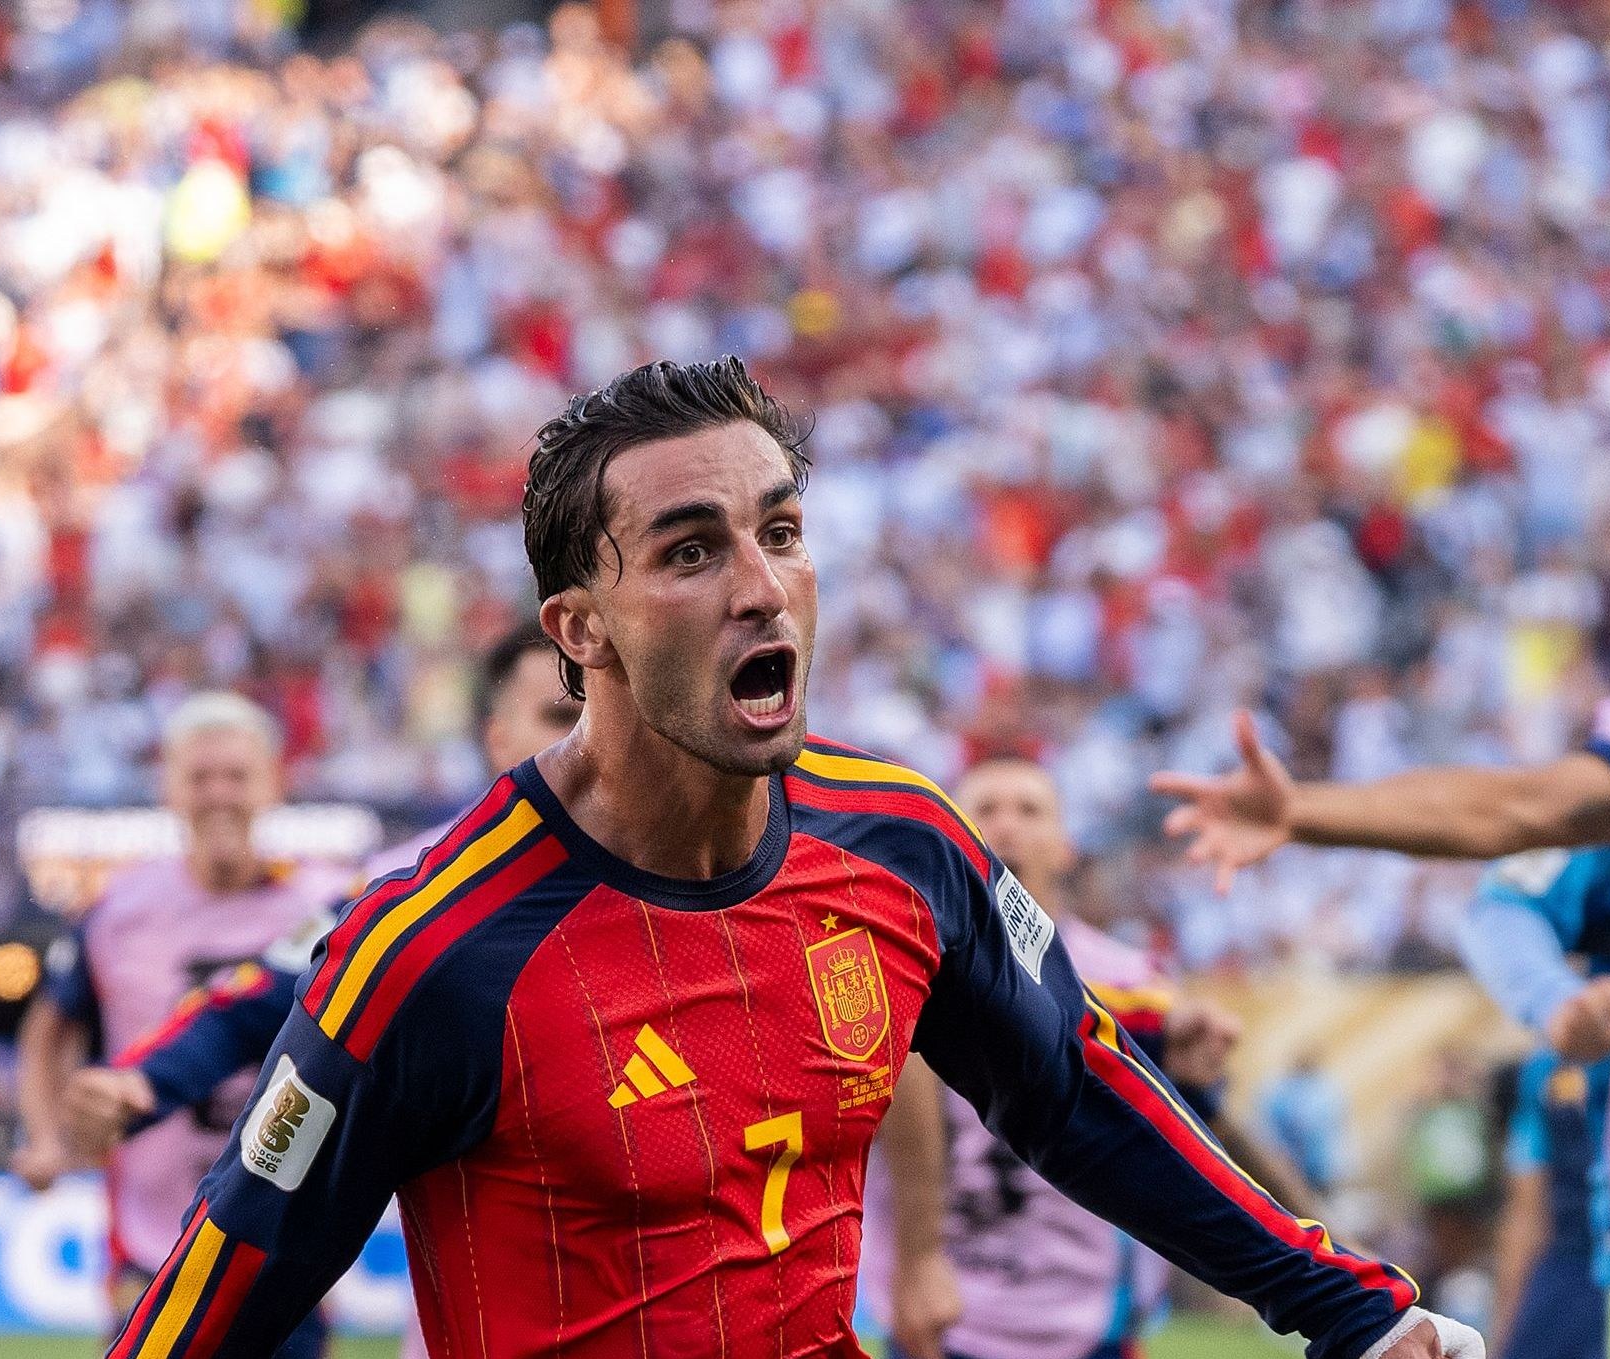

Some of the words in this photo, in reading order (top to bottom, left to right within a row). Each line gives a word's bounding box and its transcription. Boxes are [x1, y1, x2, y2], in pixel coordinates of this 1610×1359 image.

[1030, 924, 1043, 946] FIFA
[248, 1149, 278, 1173] 026
[266, 1151, 282, 1164] CUP
[744, 1111, 803, 1256] 7
